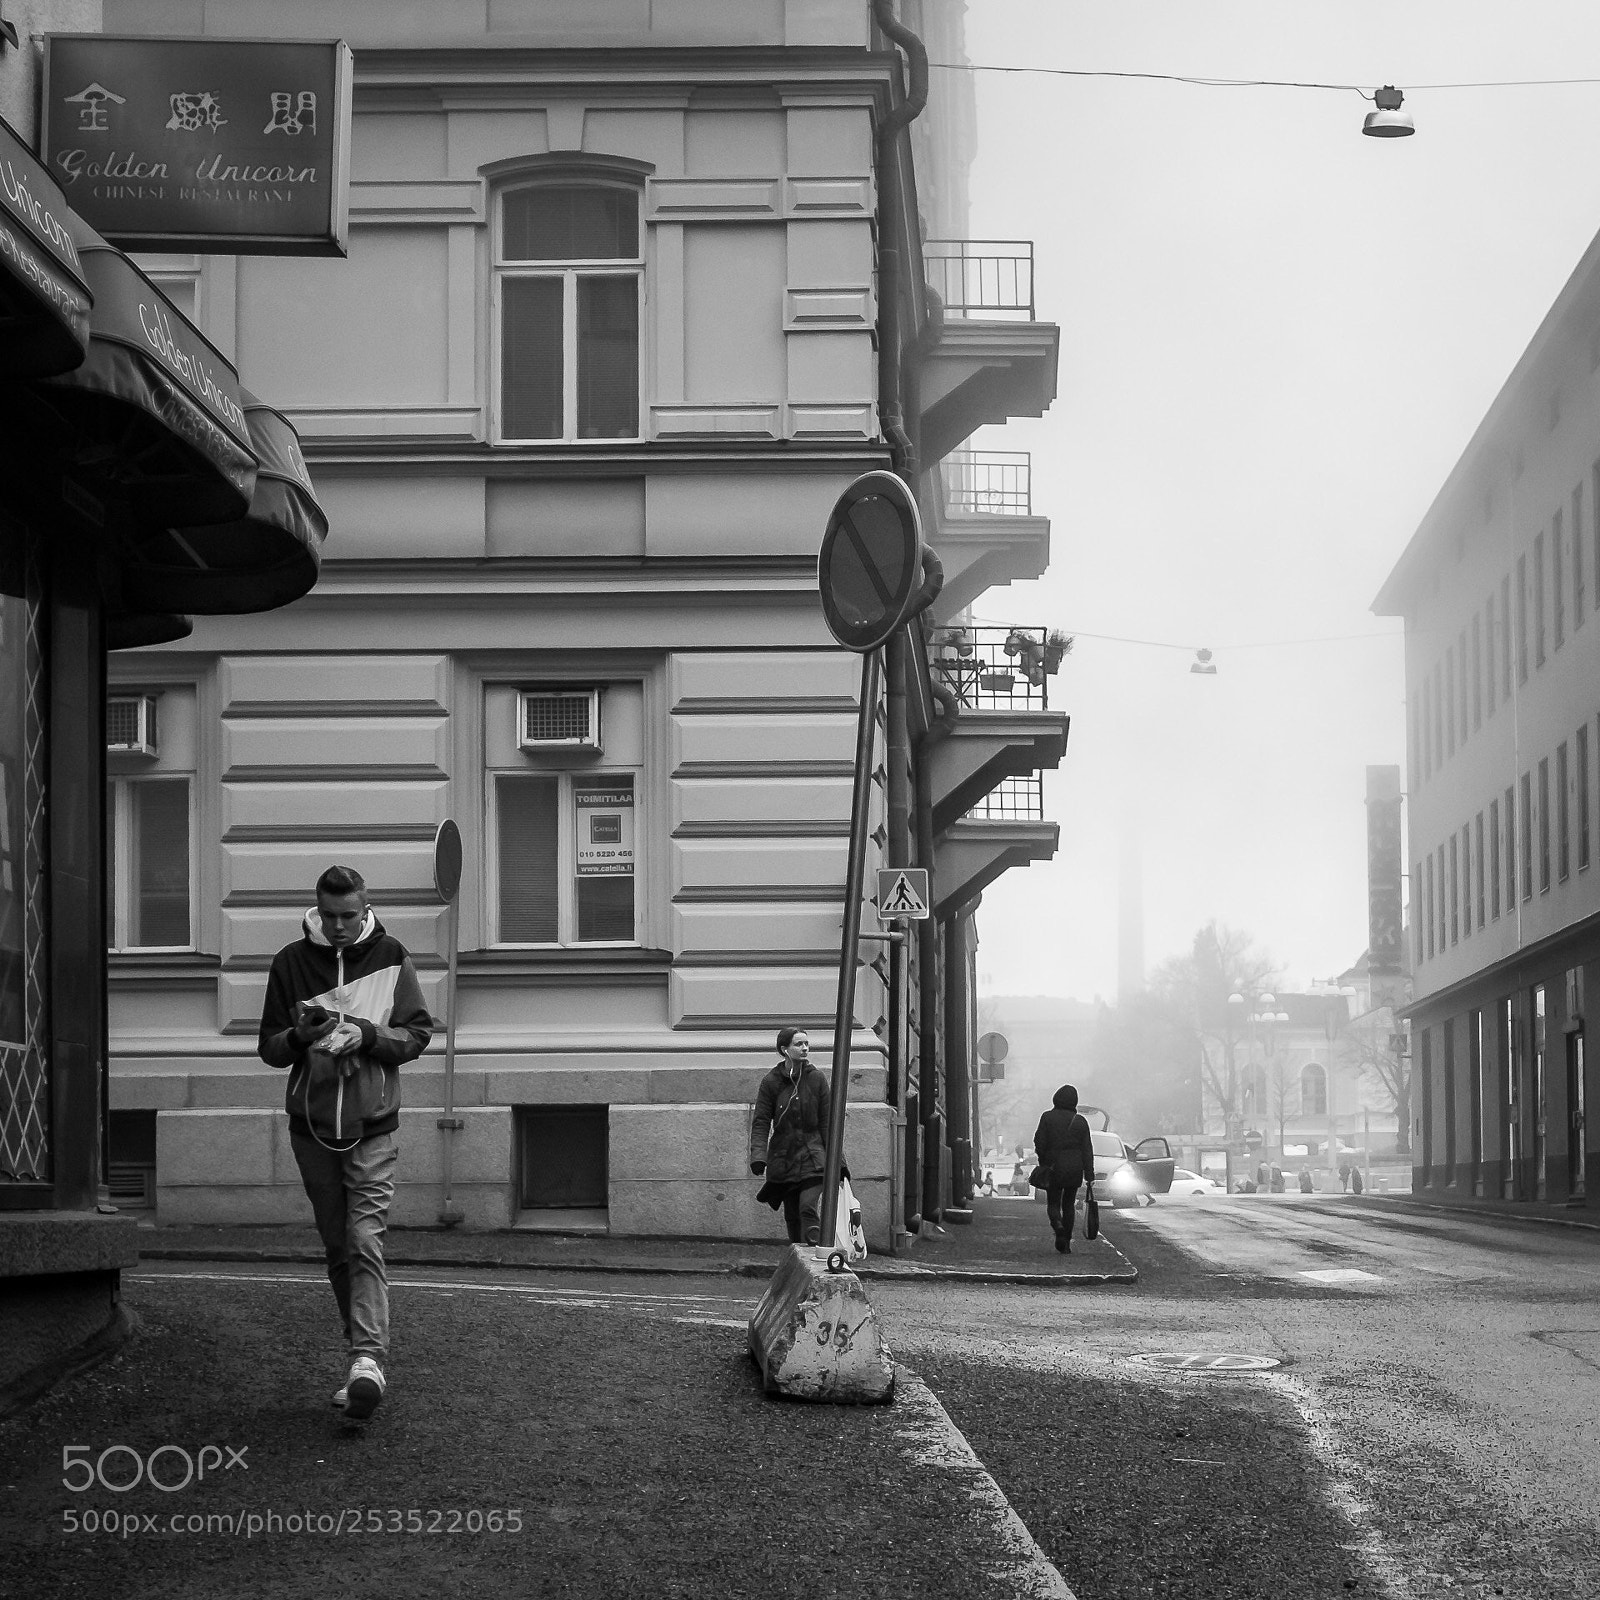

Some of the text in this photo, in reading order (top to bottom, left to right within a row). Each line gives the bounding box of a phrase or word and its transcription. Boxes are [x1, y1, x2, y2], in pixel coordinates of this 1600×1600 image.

[56, 149, 318, 186] Golden Unicorn
[93, 186, 295, 202] CHINESE RESTAURANT
[138, 303, 249, 436] Golden Unicorn
